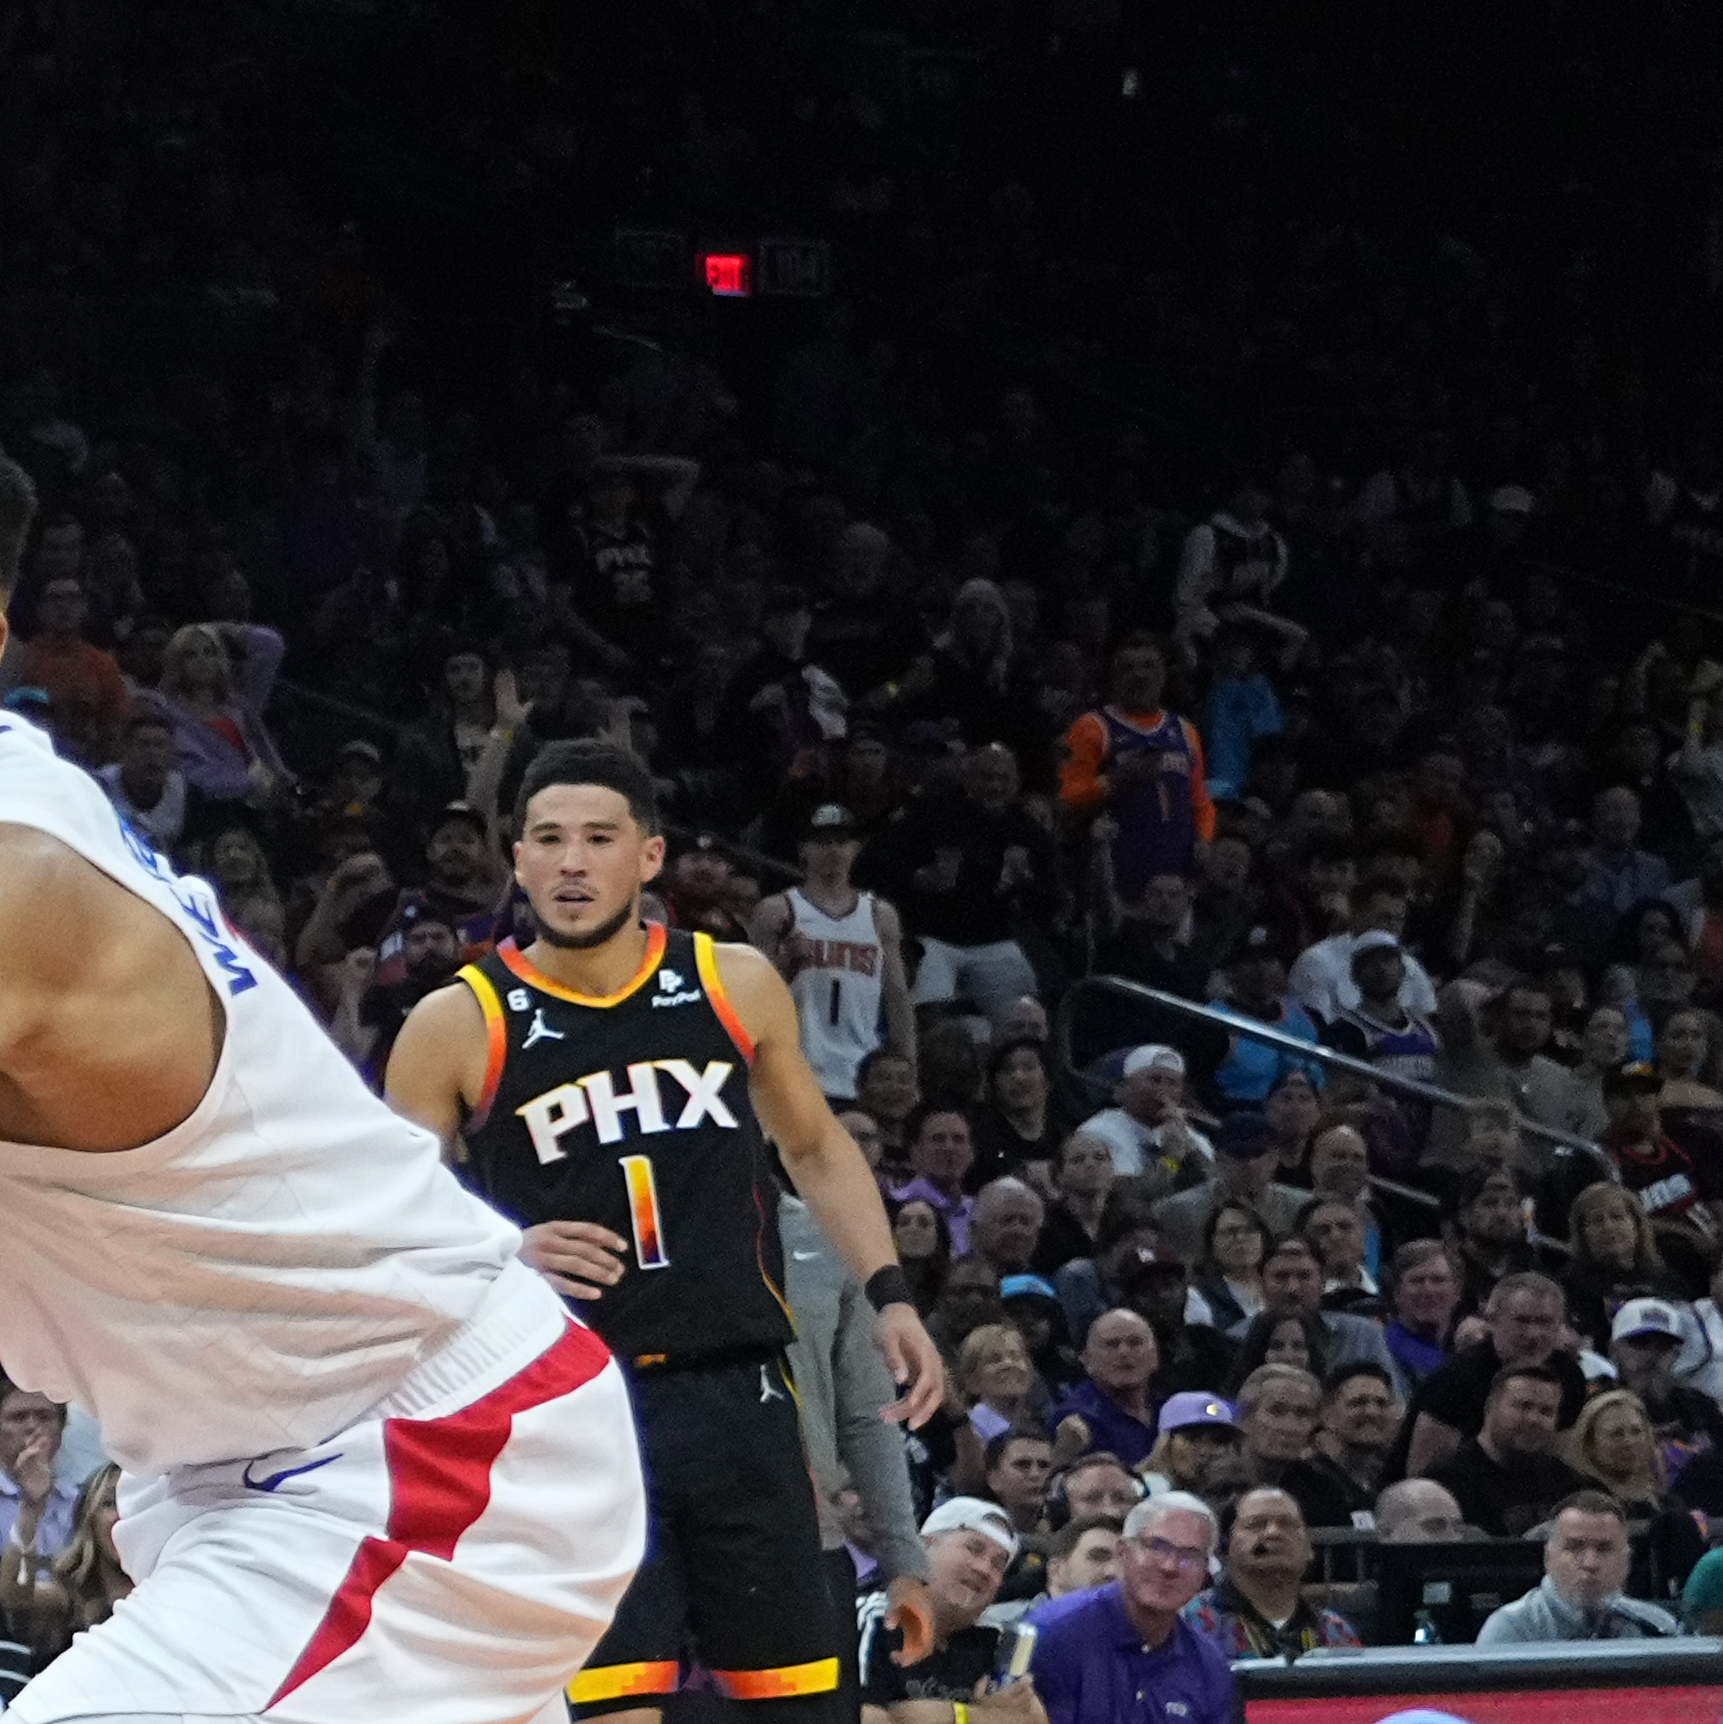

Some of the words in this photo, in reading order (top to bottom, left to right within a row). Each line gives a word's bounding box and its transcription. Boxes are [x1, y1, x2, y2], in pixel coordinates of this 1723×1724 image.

[507, 988, 530, 1012] 6
[652, 989, 701, 1009] PayPal
[515, 1058, 739, 1165] PHX
[618, 1155, 670, 1269] 1
